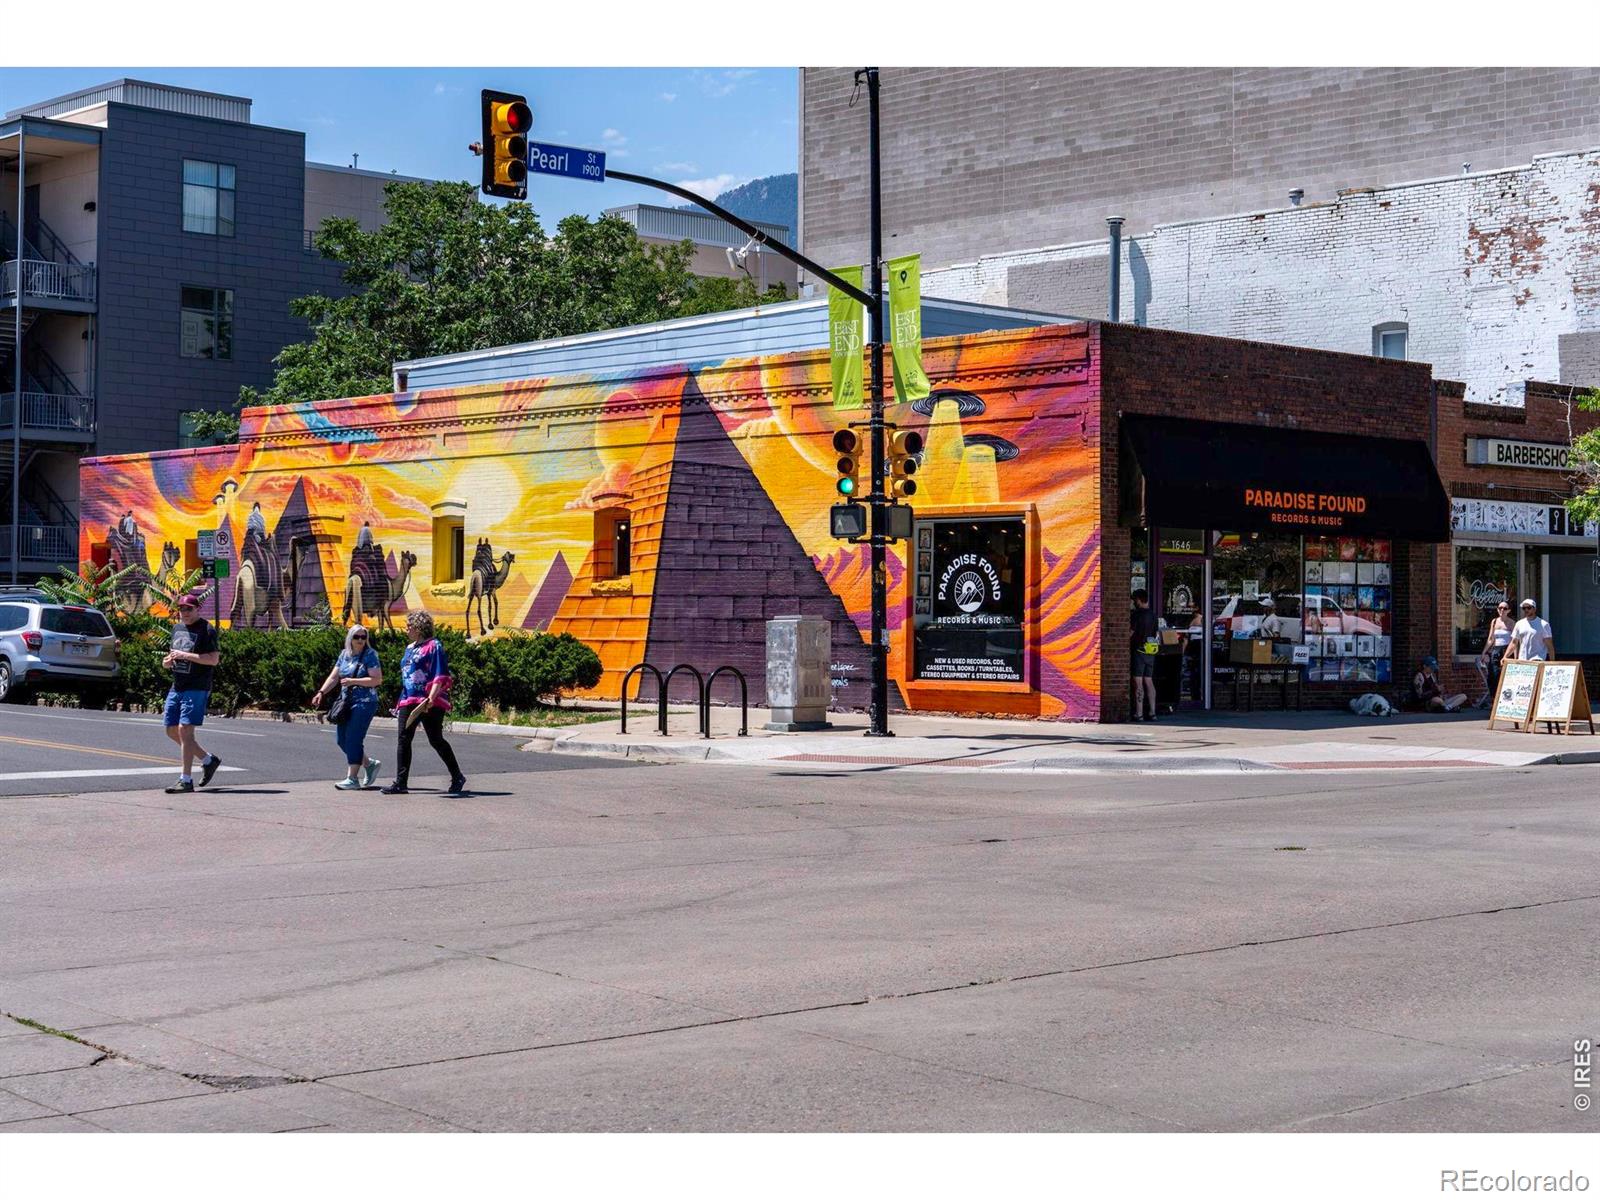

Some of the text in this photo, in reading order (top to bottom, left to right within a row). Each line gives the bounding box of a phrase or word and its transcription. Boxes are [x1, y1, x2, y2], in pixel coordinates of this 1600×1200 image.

[531, 147, 597, 171] Pearl St
[582, 164, 600, 177] 1900
[896, 324, 917, 344] END
[834, 335, 860, 351] END
[1245, 488, 1366, 512] PARADISE FOUND
[1271, 513, 1342, 526] RECORDS & MUSIC
[1171, 540, 1191, 550] 1646
[938, 553, 1001, 600] PARADISE FOUND
[926, 664, 957, 672] CASSETTES,
[966, 658, 992, 666] RECORDS,
